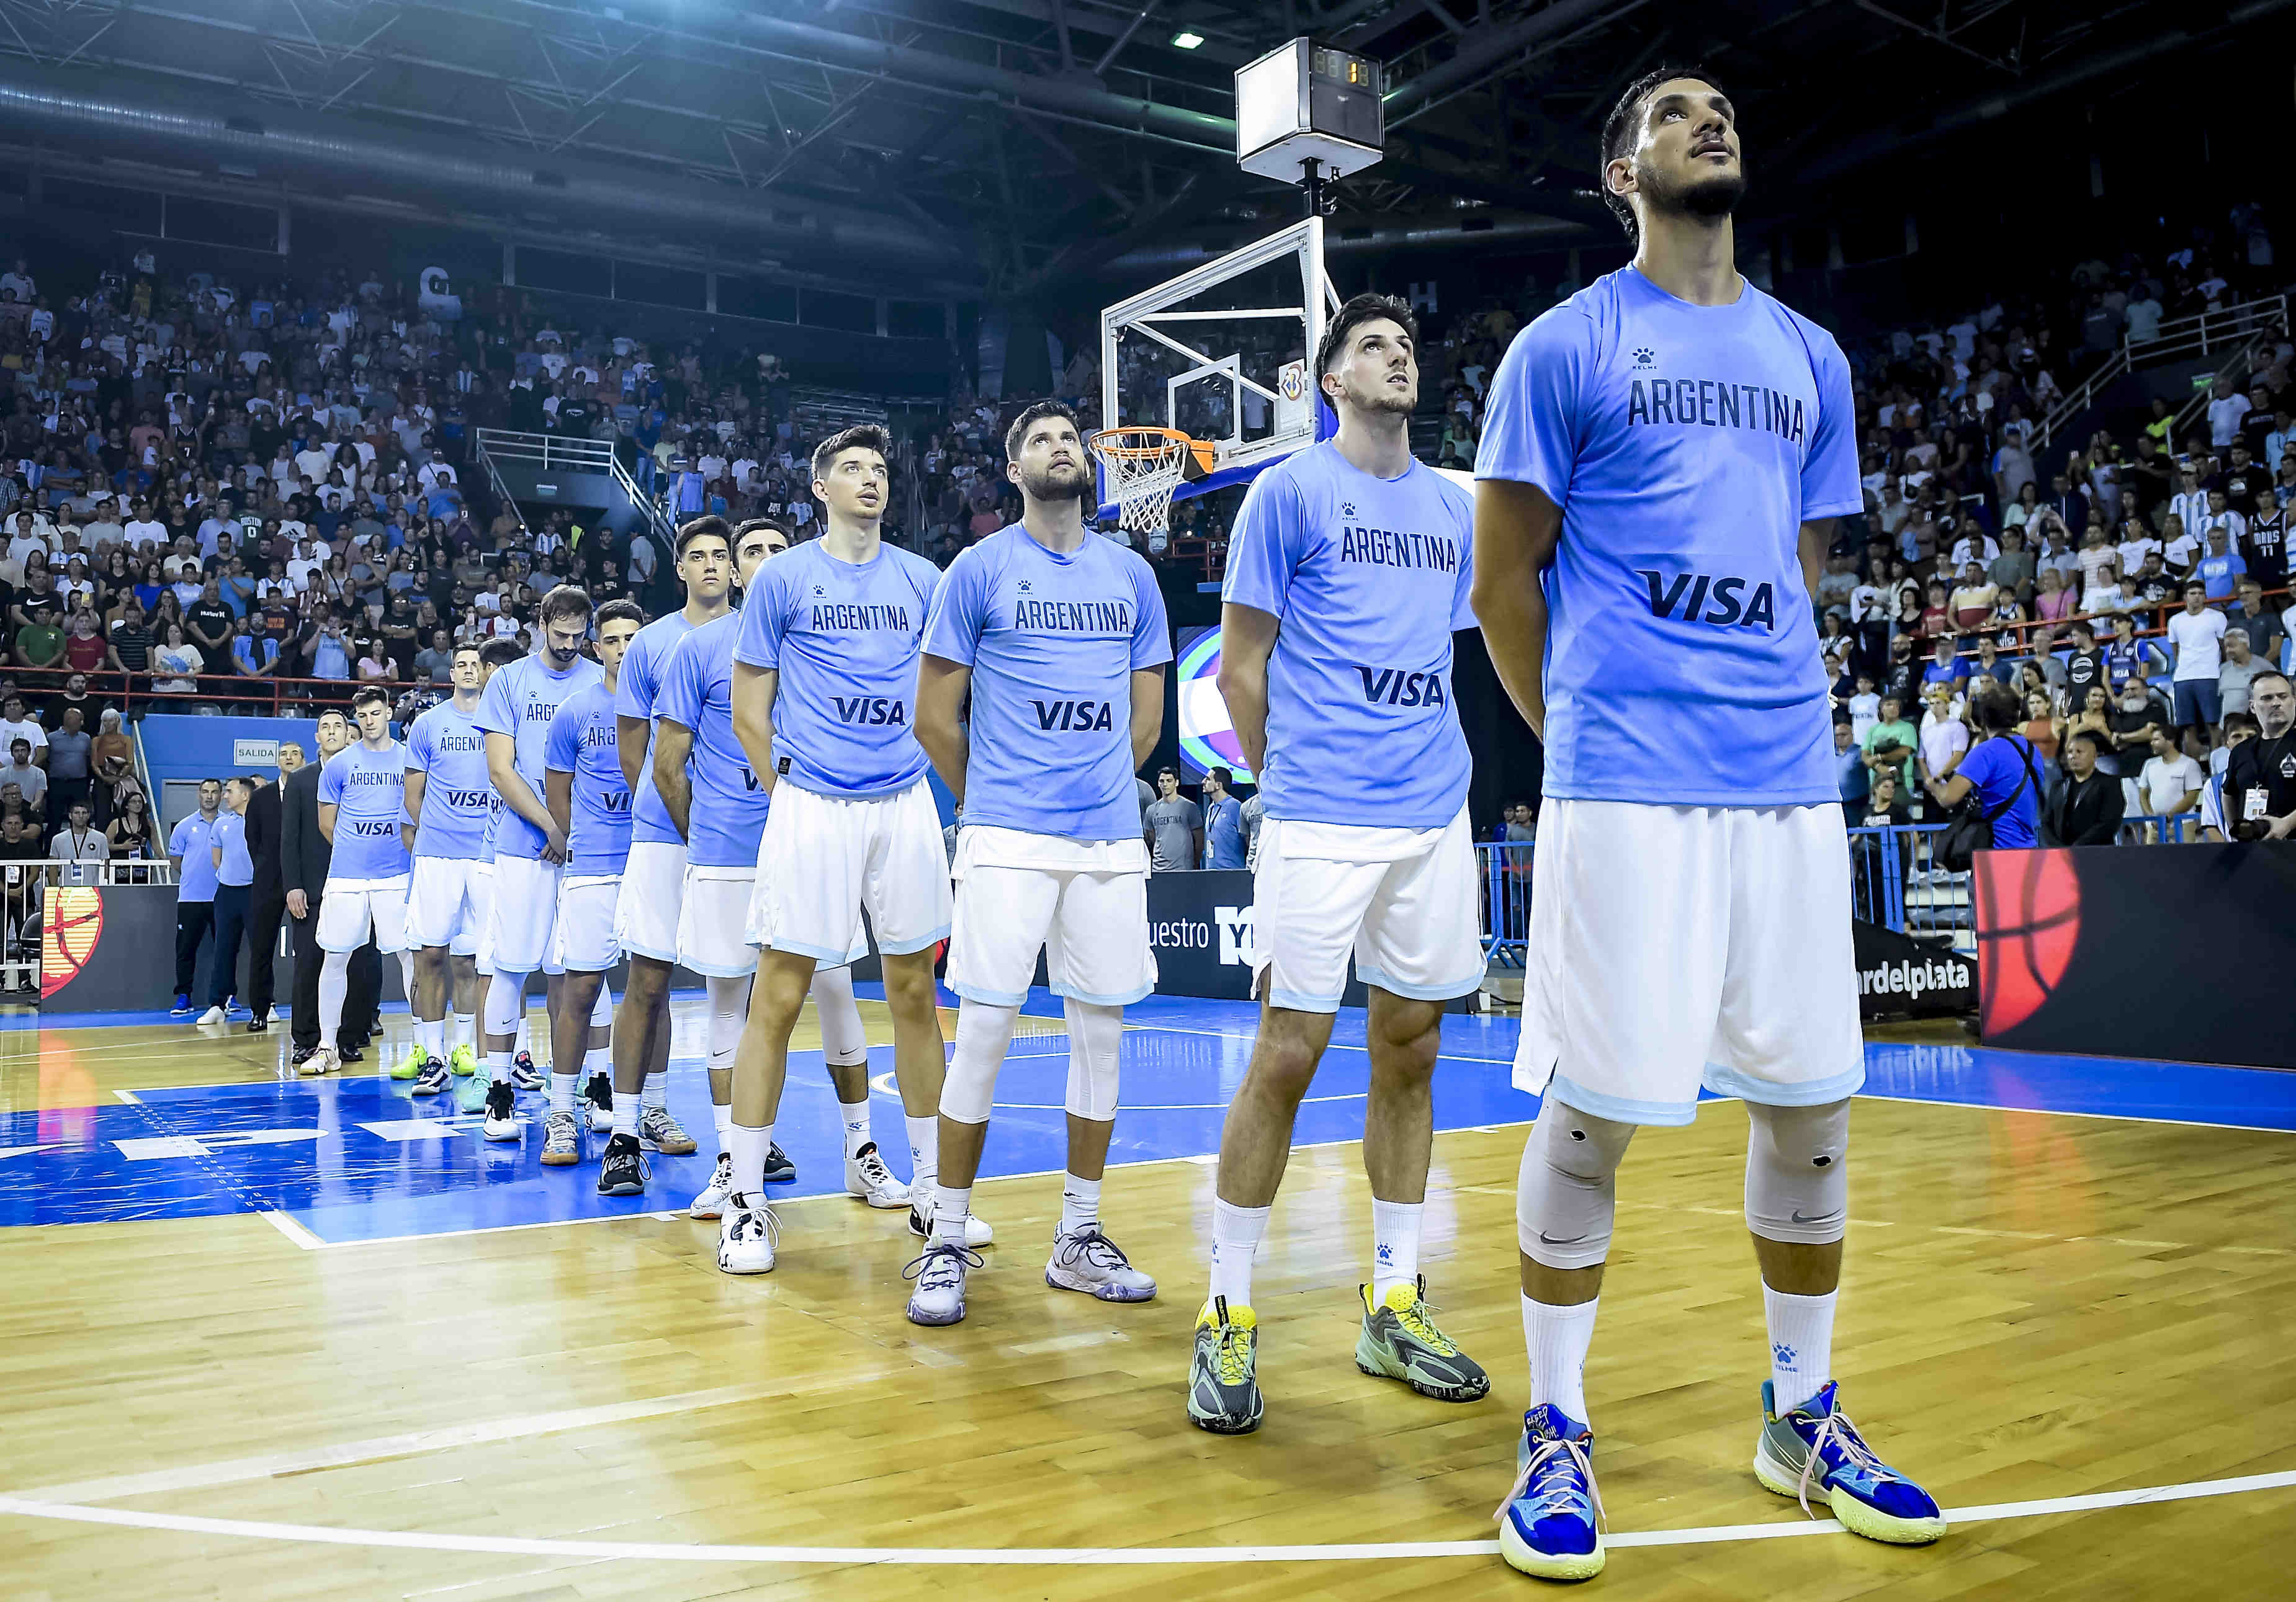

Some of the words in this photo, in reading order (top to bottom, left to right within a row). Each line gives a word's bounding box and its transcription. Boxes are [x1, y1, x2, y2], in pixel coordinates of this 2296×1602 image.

[1409, 282, 1437, 313] H
[1628, 379, 1803, 447] ARGENTINA
[1340, 526, 1456, 574] ARGENTINA
[1015, 600, 1129, 632] ARGENTINA
[1634, 570, 1774, 631] VISA
[812, 604, 909, 631] ARGENTINA
[1352, 665, 1444, 710] VISA
[828, 697, 906, 726] VISA
[1027, 700, 1112, 732] VISA
[238, 749, 274, 757] SALIDA
[349, 772, 405, 787] ARGENTINA
[446, 791, 488, 807] VISA
[352, 822, 394, 836] VISA
